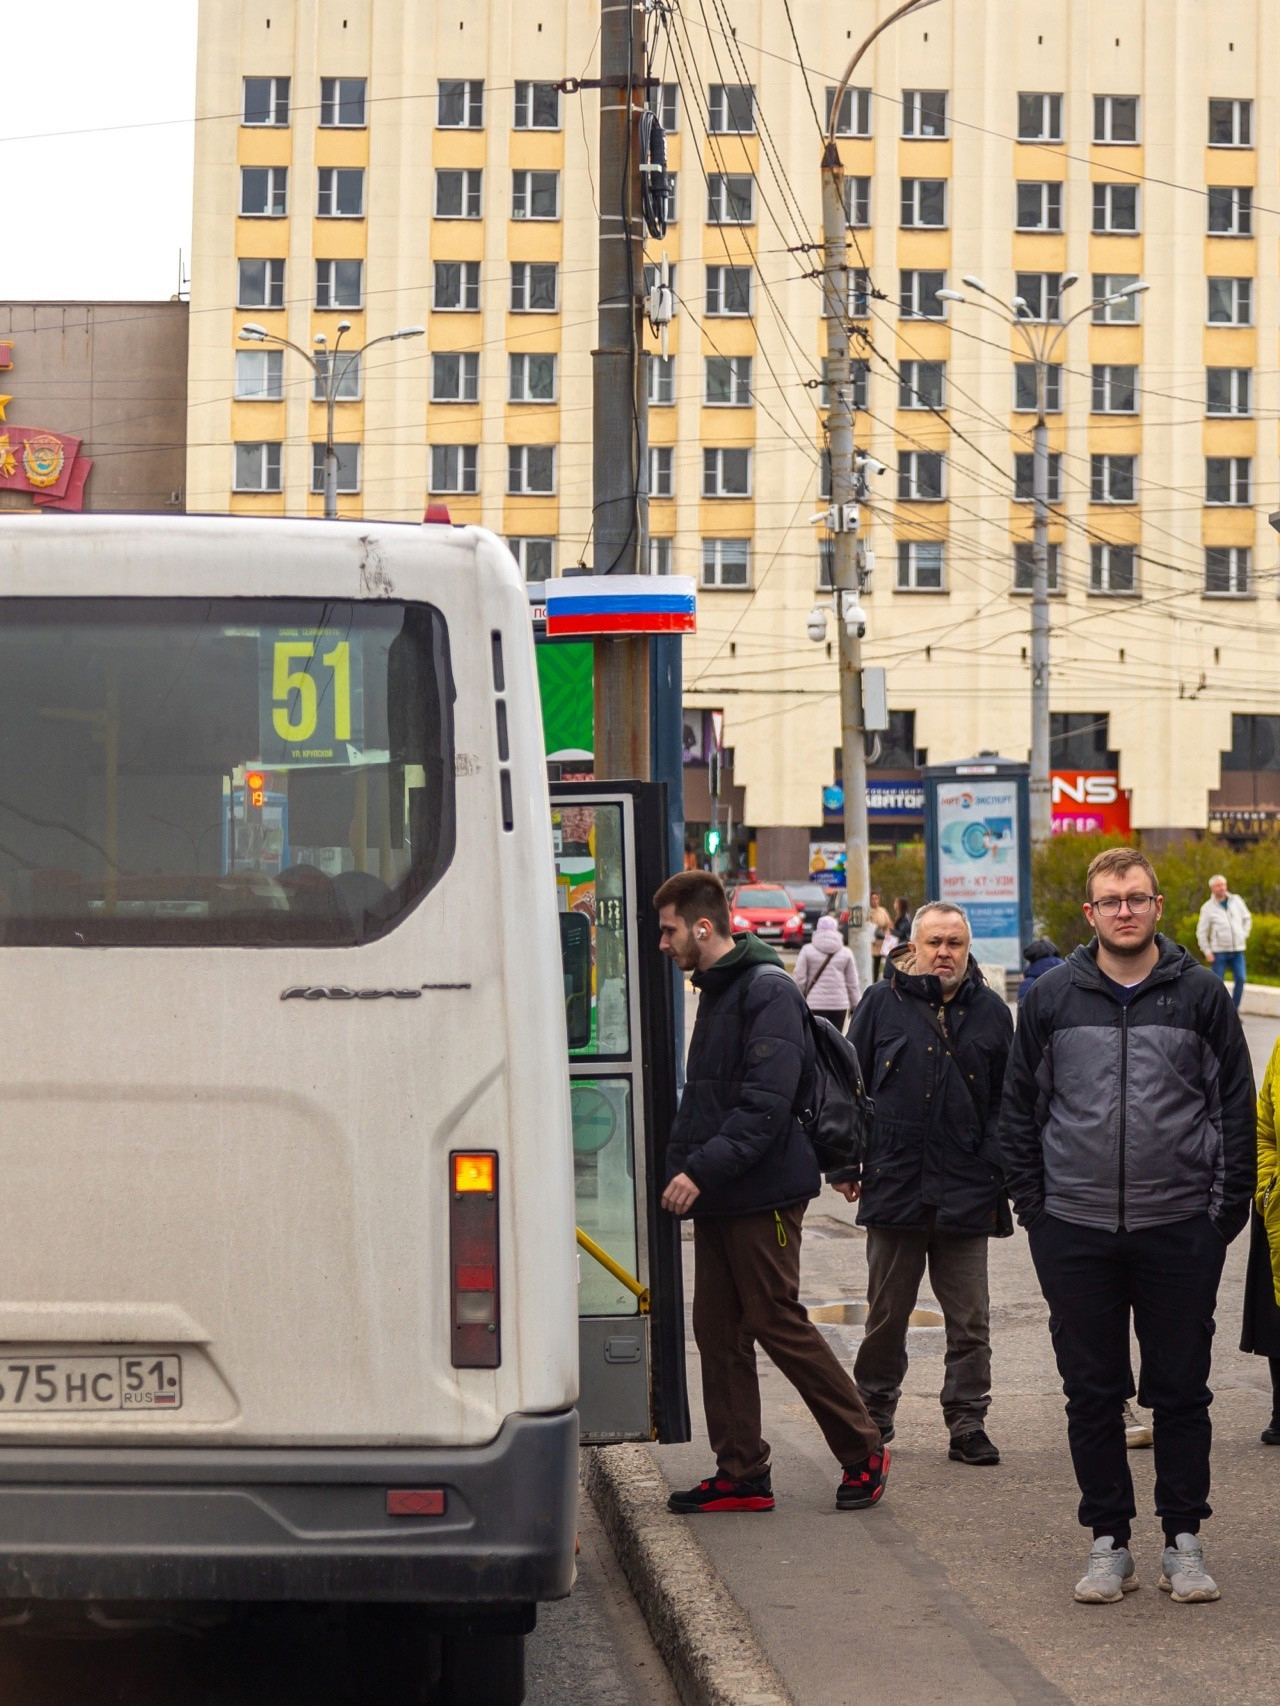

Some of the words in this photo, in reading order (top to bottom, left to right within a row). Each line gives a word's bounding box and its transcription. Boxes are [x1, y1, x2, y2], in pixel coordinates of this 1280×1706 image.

[272, 641, 351, 742] 51
[0, 1364, 113, 1403] 75НС
[125, 1361, 164, 1391] 51
[124, 1392, 153, 1403] RUS
